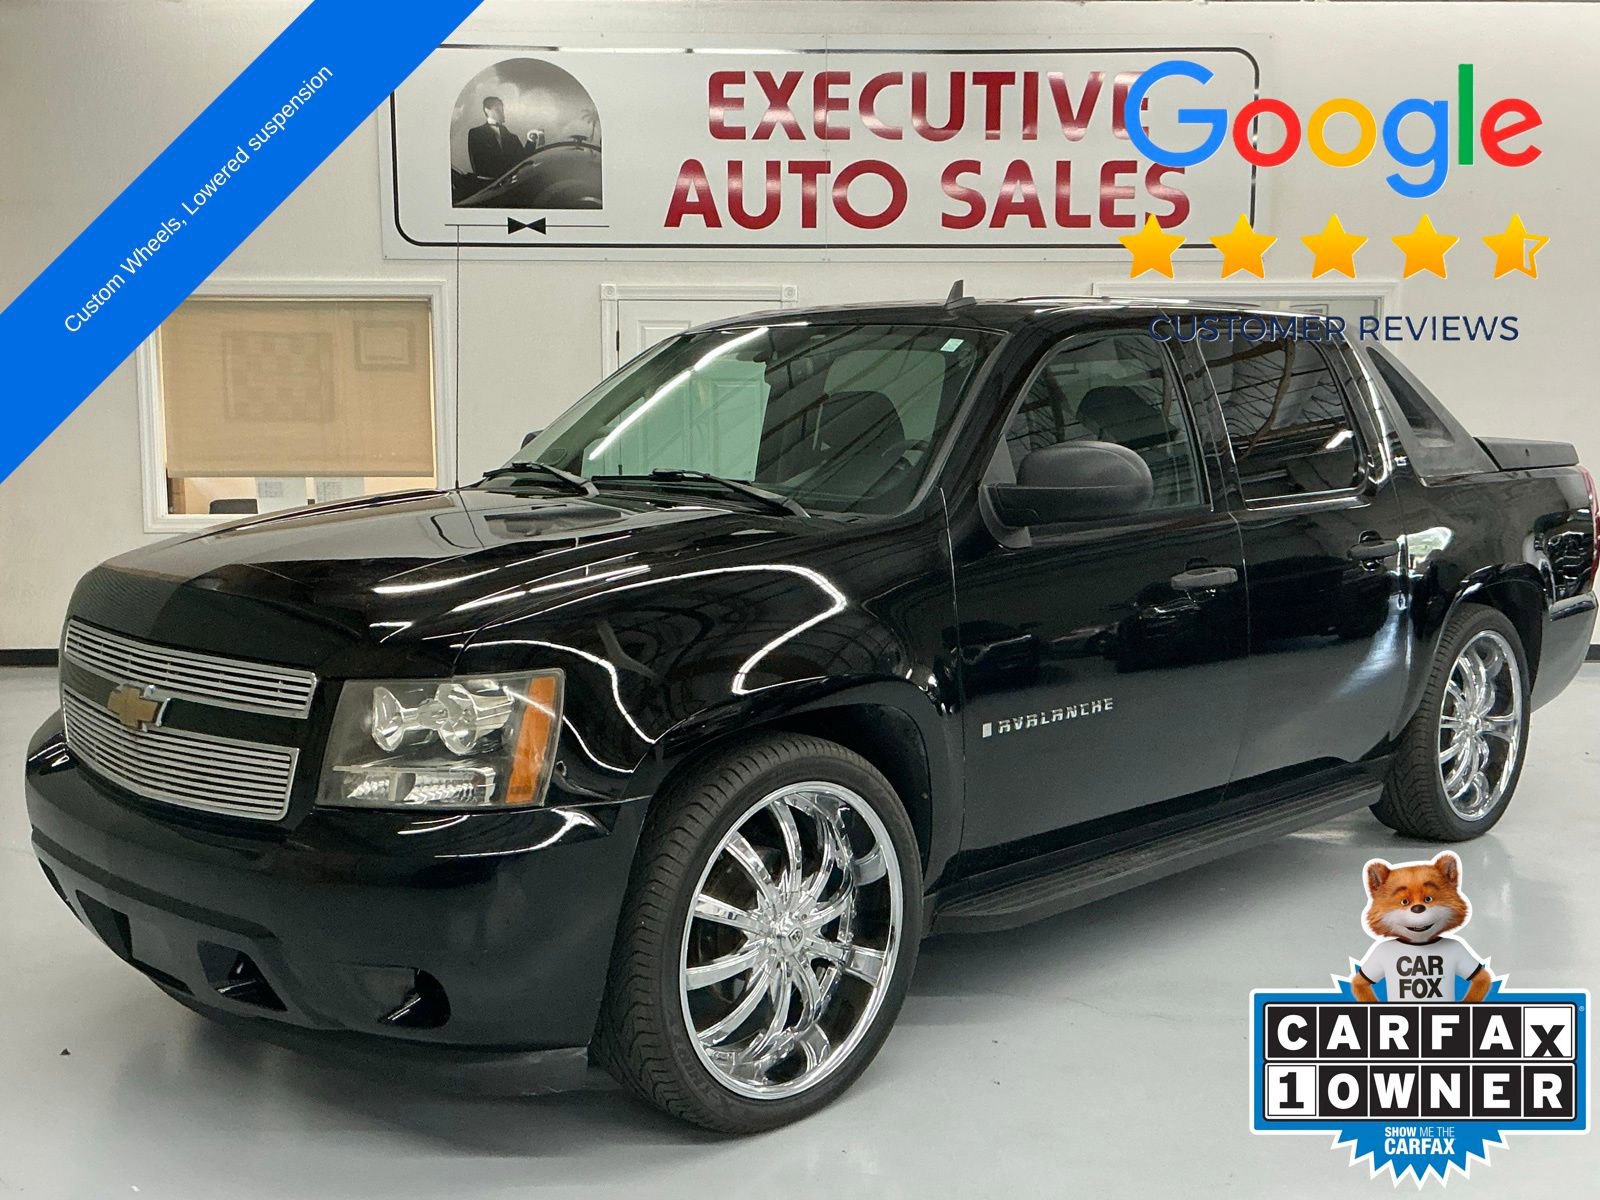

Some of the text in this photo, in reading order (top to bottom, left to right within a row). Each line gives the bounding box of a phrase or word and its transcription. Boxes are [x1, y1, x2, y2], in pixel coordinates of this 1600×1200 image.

[708, 70, 1150, 142] EXECUTIVE
[663, 158, 1191, 230] AUTO SALES
[998, 697, 1114, 734] AVALANCHE
